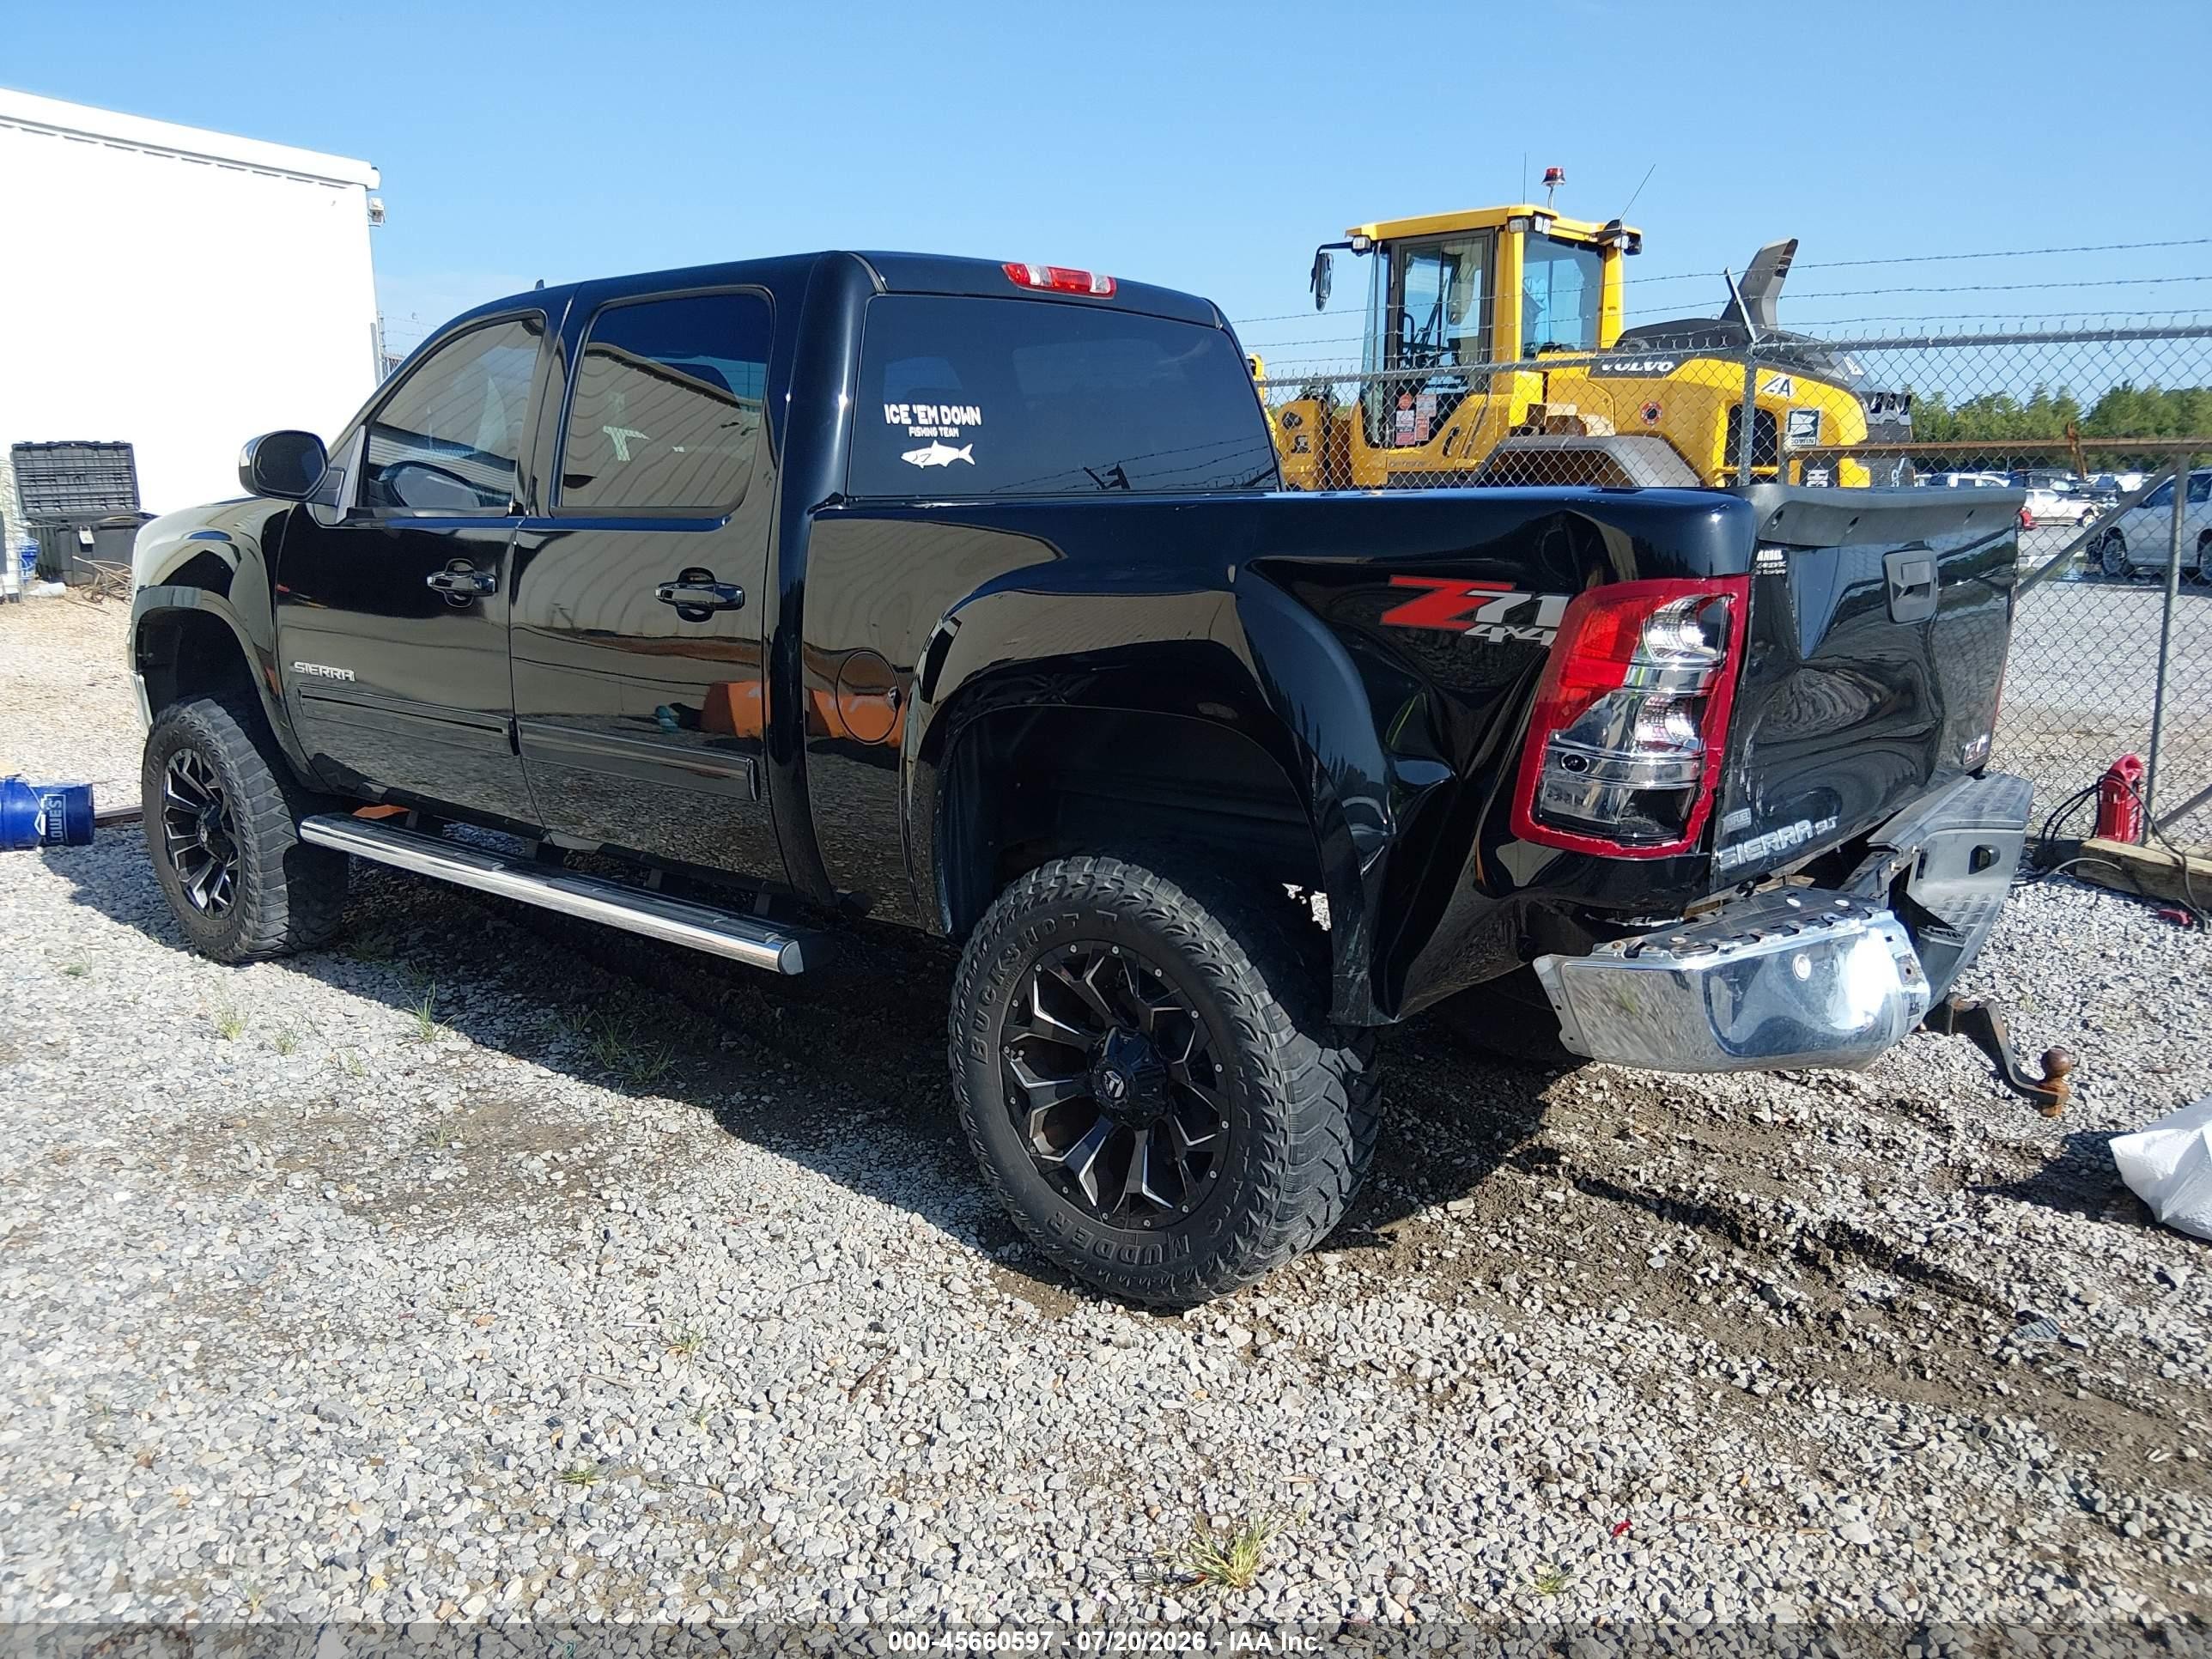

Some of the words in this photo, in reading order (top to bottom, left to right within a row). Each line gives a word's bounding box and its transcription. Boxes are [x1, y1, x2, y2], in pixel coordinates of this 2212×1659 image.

[1601, 361, 1674, 372] VOLVO
[884, 404, 912, 424] ICE
[912, 404, 939, 425] 'EM
[939, 404, 981, 426] DOWN
[908, 426, 938, 438] FISHING
[939, 427, 960, 438] TEAM
[1379, 574, 1571, 630] Z71
[294, 661, 356, 682] SIERRA
[1718, 819, 1813, 872] SIERRA
[969, 911, 1080, 1066] BUCKSHOT
[1044, 1211, 1190, 1267] MUDDER
